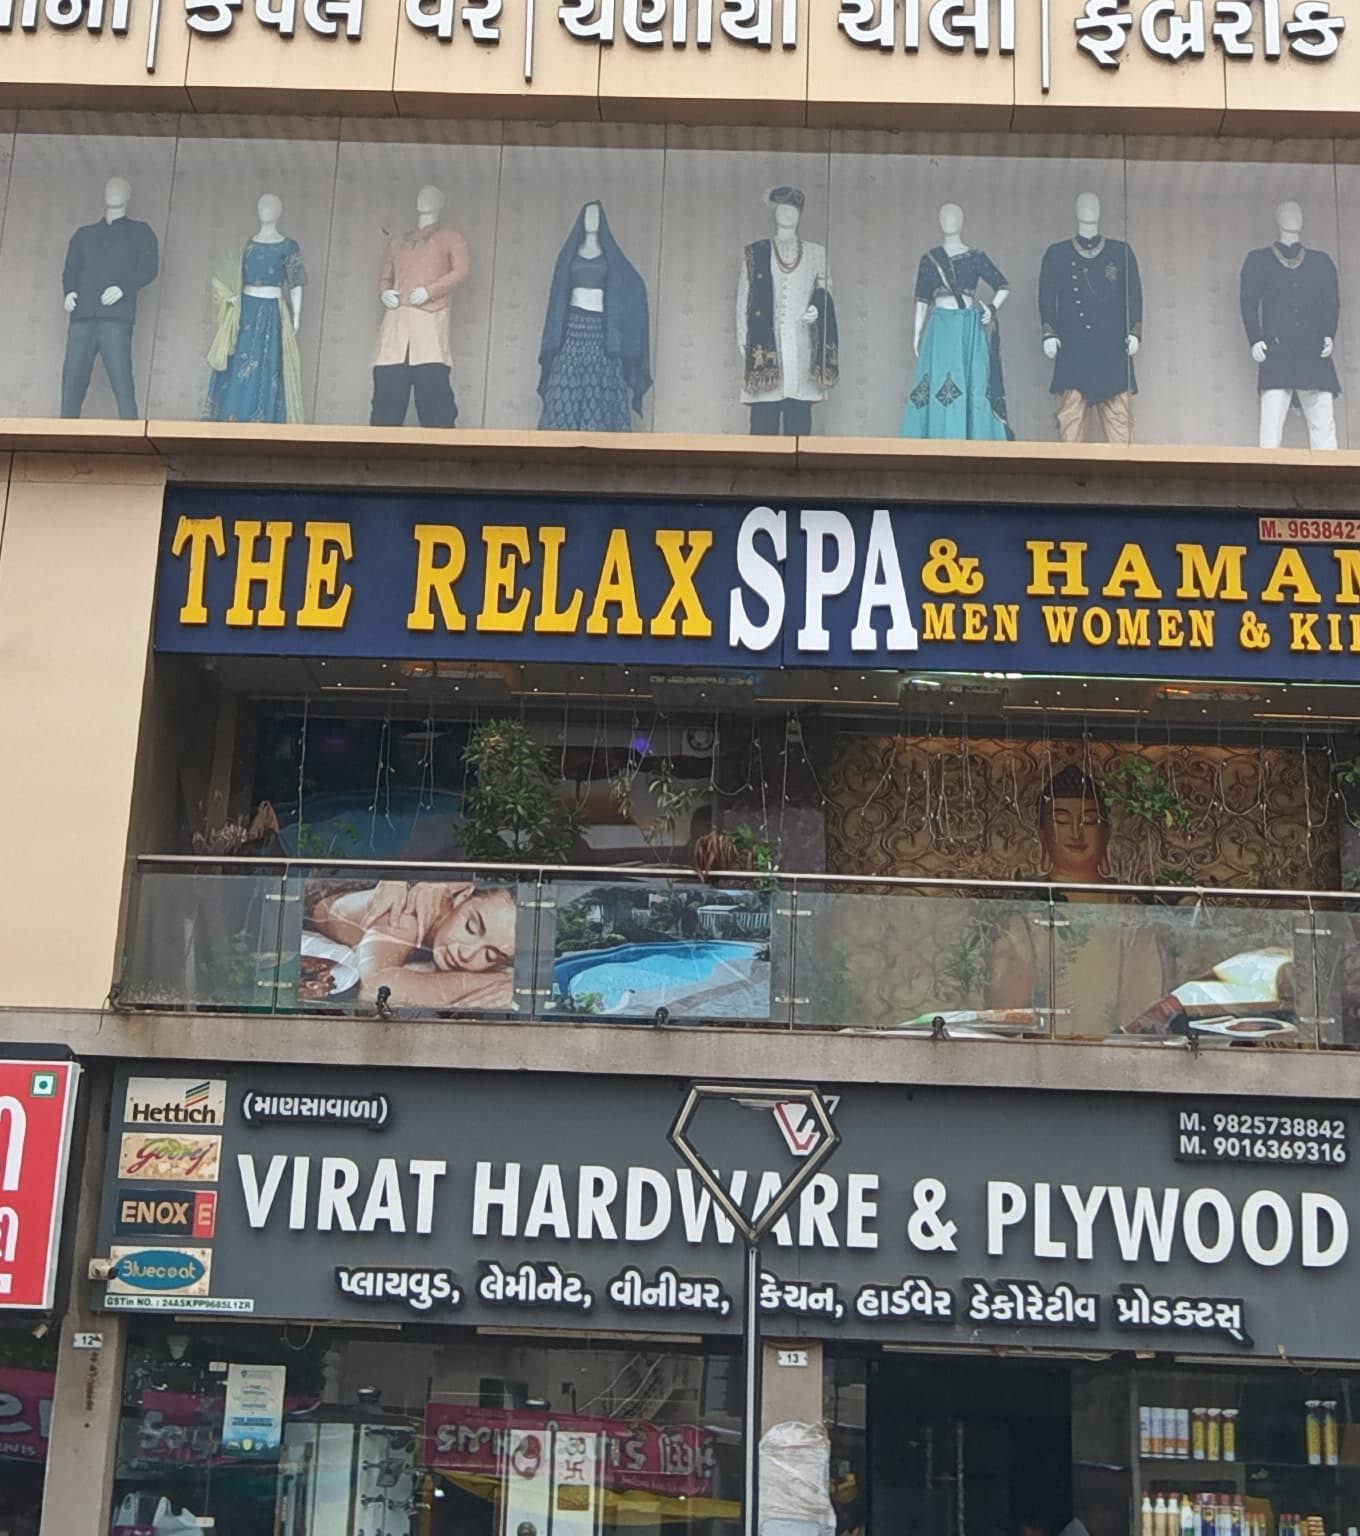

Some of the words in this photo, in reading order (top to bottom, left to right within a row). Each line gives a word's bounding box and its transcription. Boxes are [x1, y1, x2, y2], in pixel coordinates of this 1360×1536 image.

[1261, 520, 1283, 539] M.
[171, 515, 354, 628] THE
[407, 525, 713, 637] RELAX
[729, 506, 918, 652] SPA
[921, 537, 984, 595] &
[922, 603, 1019, 643] MEN
[1042, 605, 1215, 648] WOMEN
[1240, 611, 1270, 649] &
[133, 1103, 215, 1123] Hettich
[1180, 1113, 1206, 1133] M.
[1212, 1114, 1345, 1140] 9825738842
[1179, 1135, 1206, 1155] M.
[1212, 1136, 1346, 1163] 9016369316
[121, 1201, 190, 1224] ENOX
[237, 1154, 447, 1235] VIRAT
[471, 1160, 880, 1248] HARDWARE
[908, 1178, 958, 1253] &
[986, 1181, 1349, 1268] PLYWOOD
